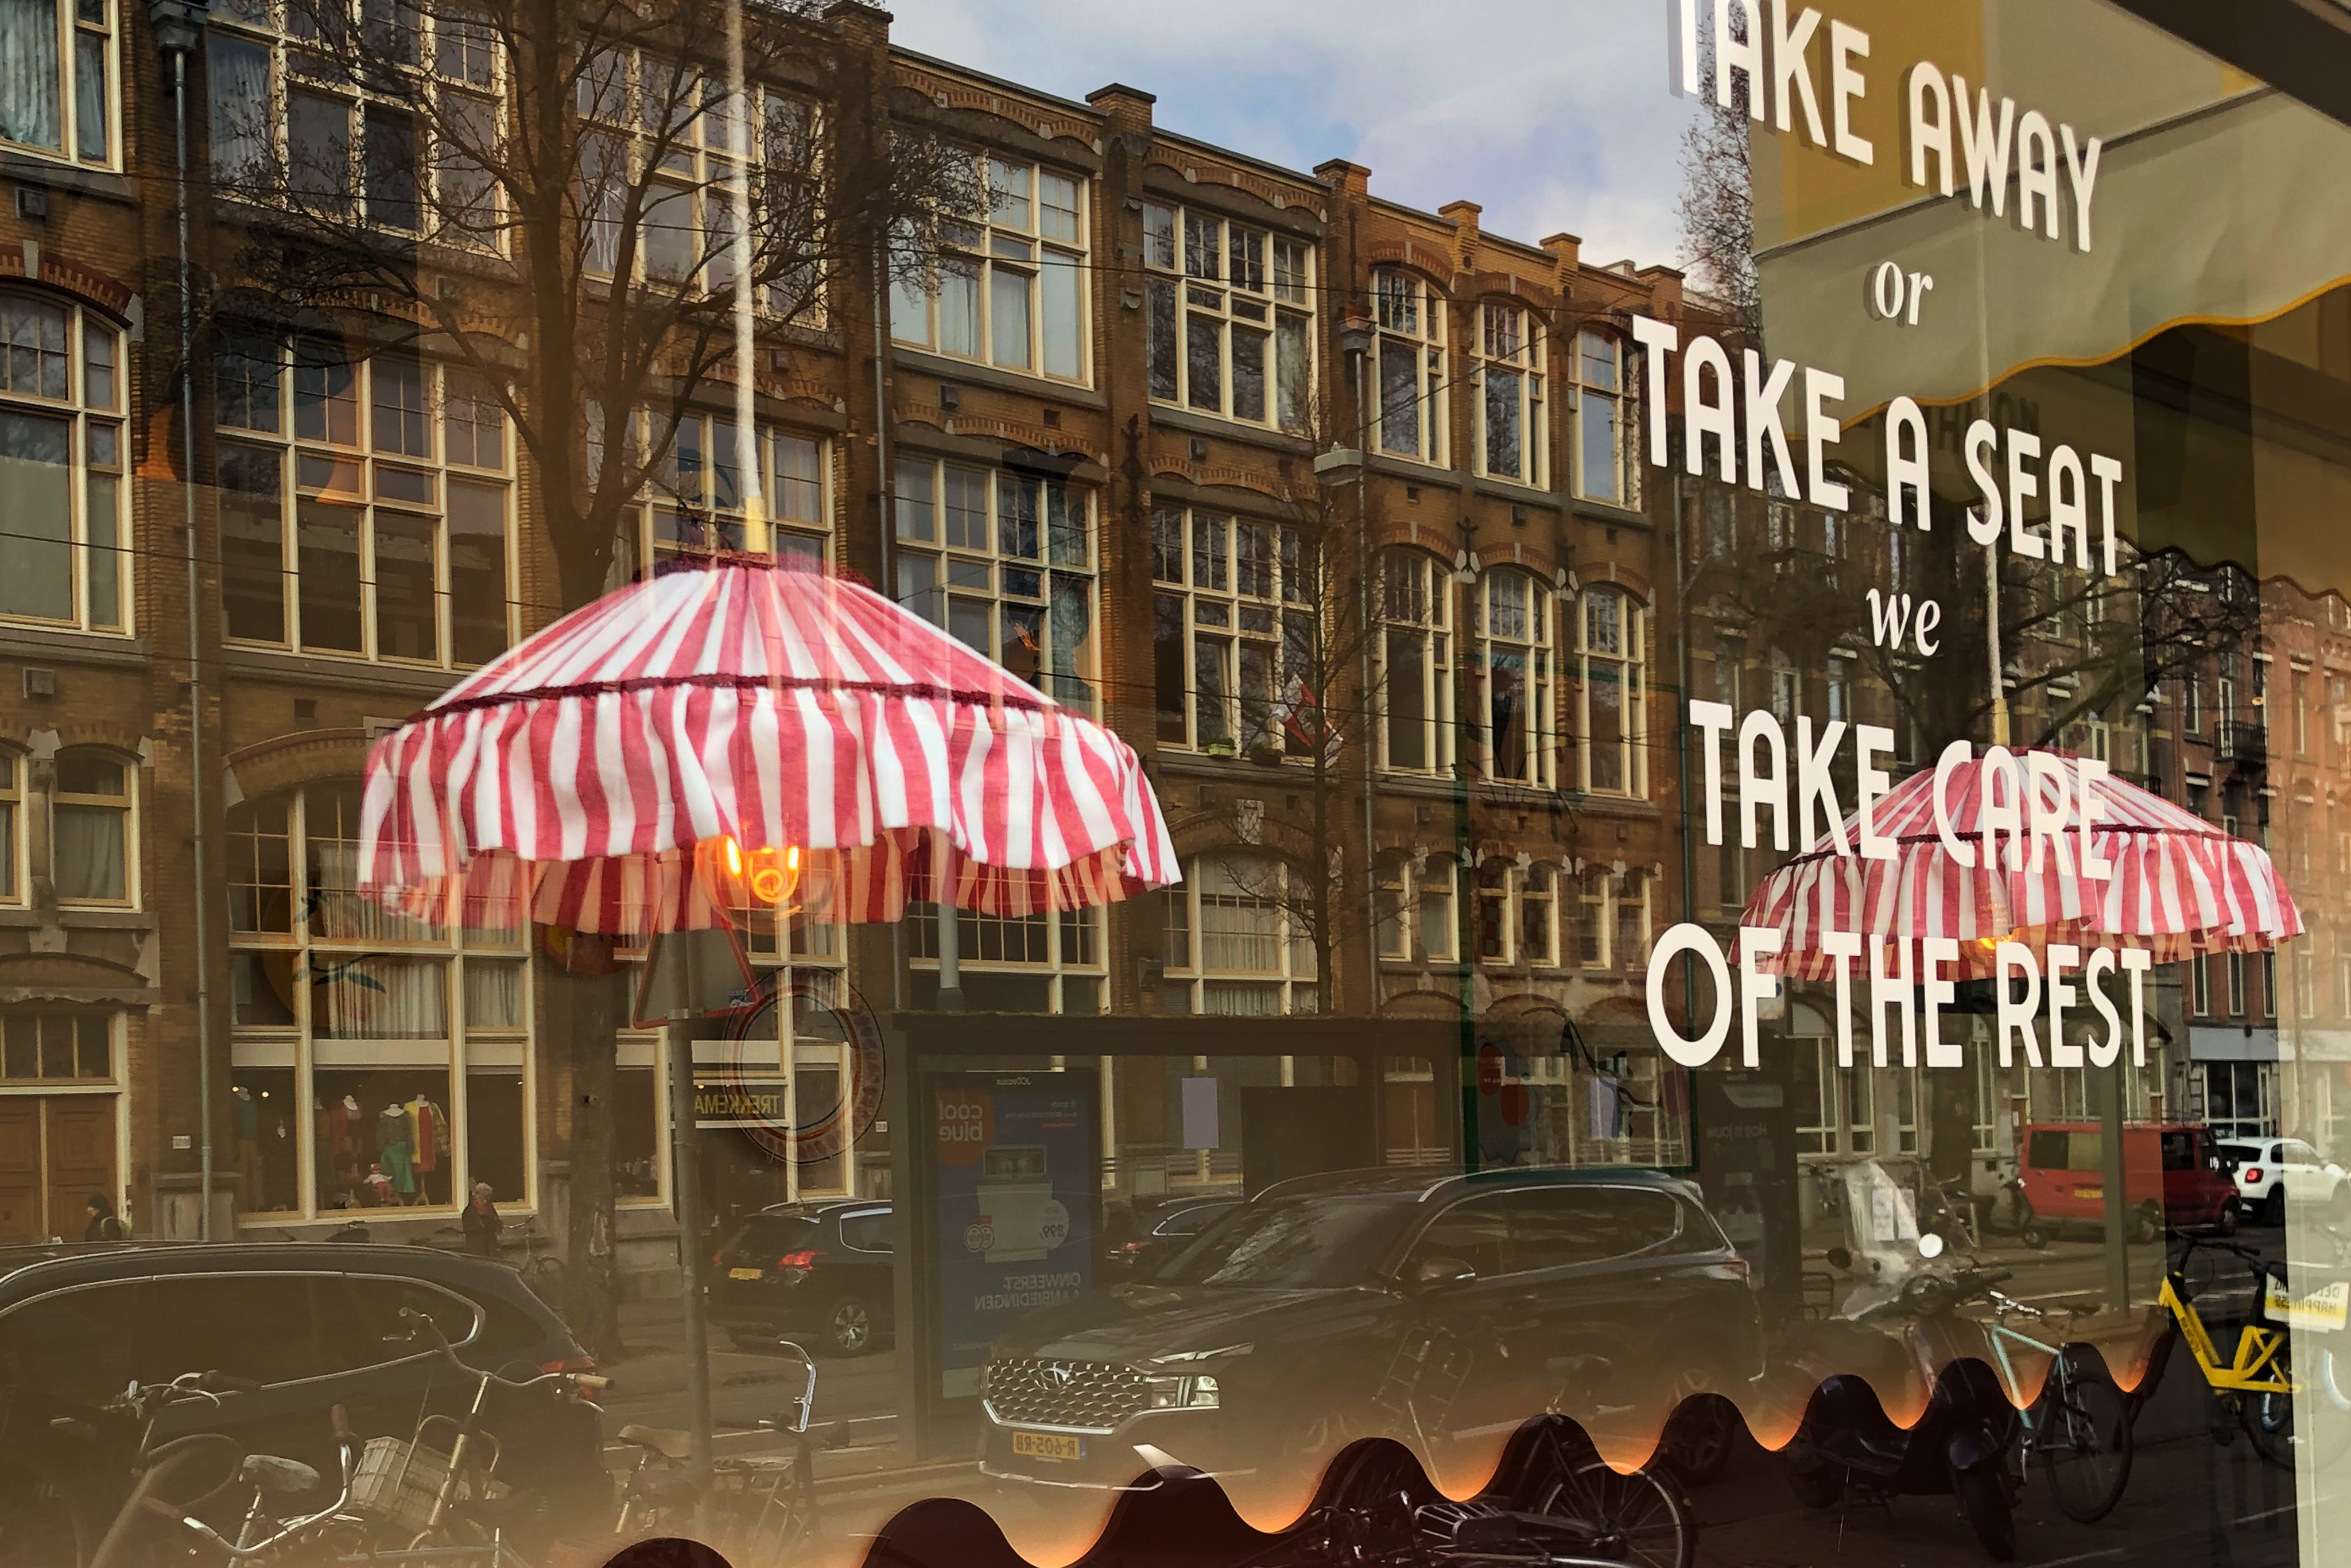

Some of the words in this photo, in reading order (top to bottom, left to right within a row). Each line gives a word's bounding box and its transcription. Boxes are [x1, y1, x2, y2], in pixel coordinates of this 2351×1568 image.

[1909, 60, 2102, 253] AWAY
[1632, 315, 1849, 511] TAKE
[1886, 396, 1931, 531] A
[1965, 419, 2122, 576] SEAT
[1866, 588, 1942, 657] we
[1689, 700, 1898, 860] TAKE
[1933, 740, 2112, 880] CARE
[1646, 923, 1781, 1068] OF
[1822, 931, 1963, 1068] THE
[1996, 941, 2151, 1068] REST
